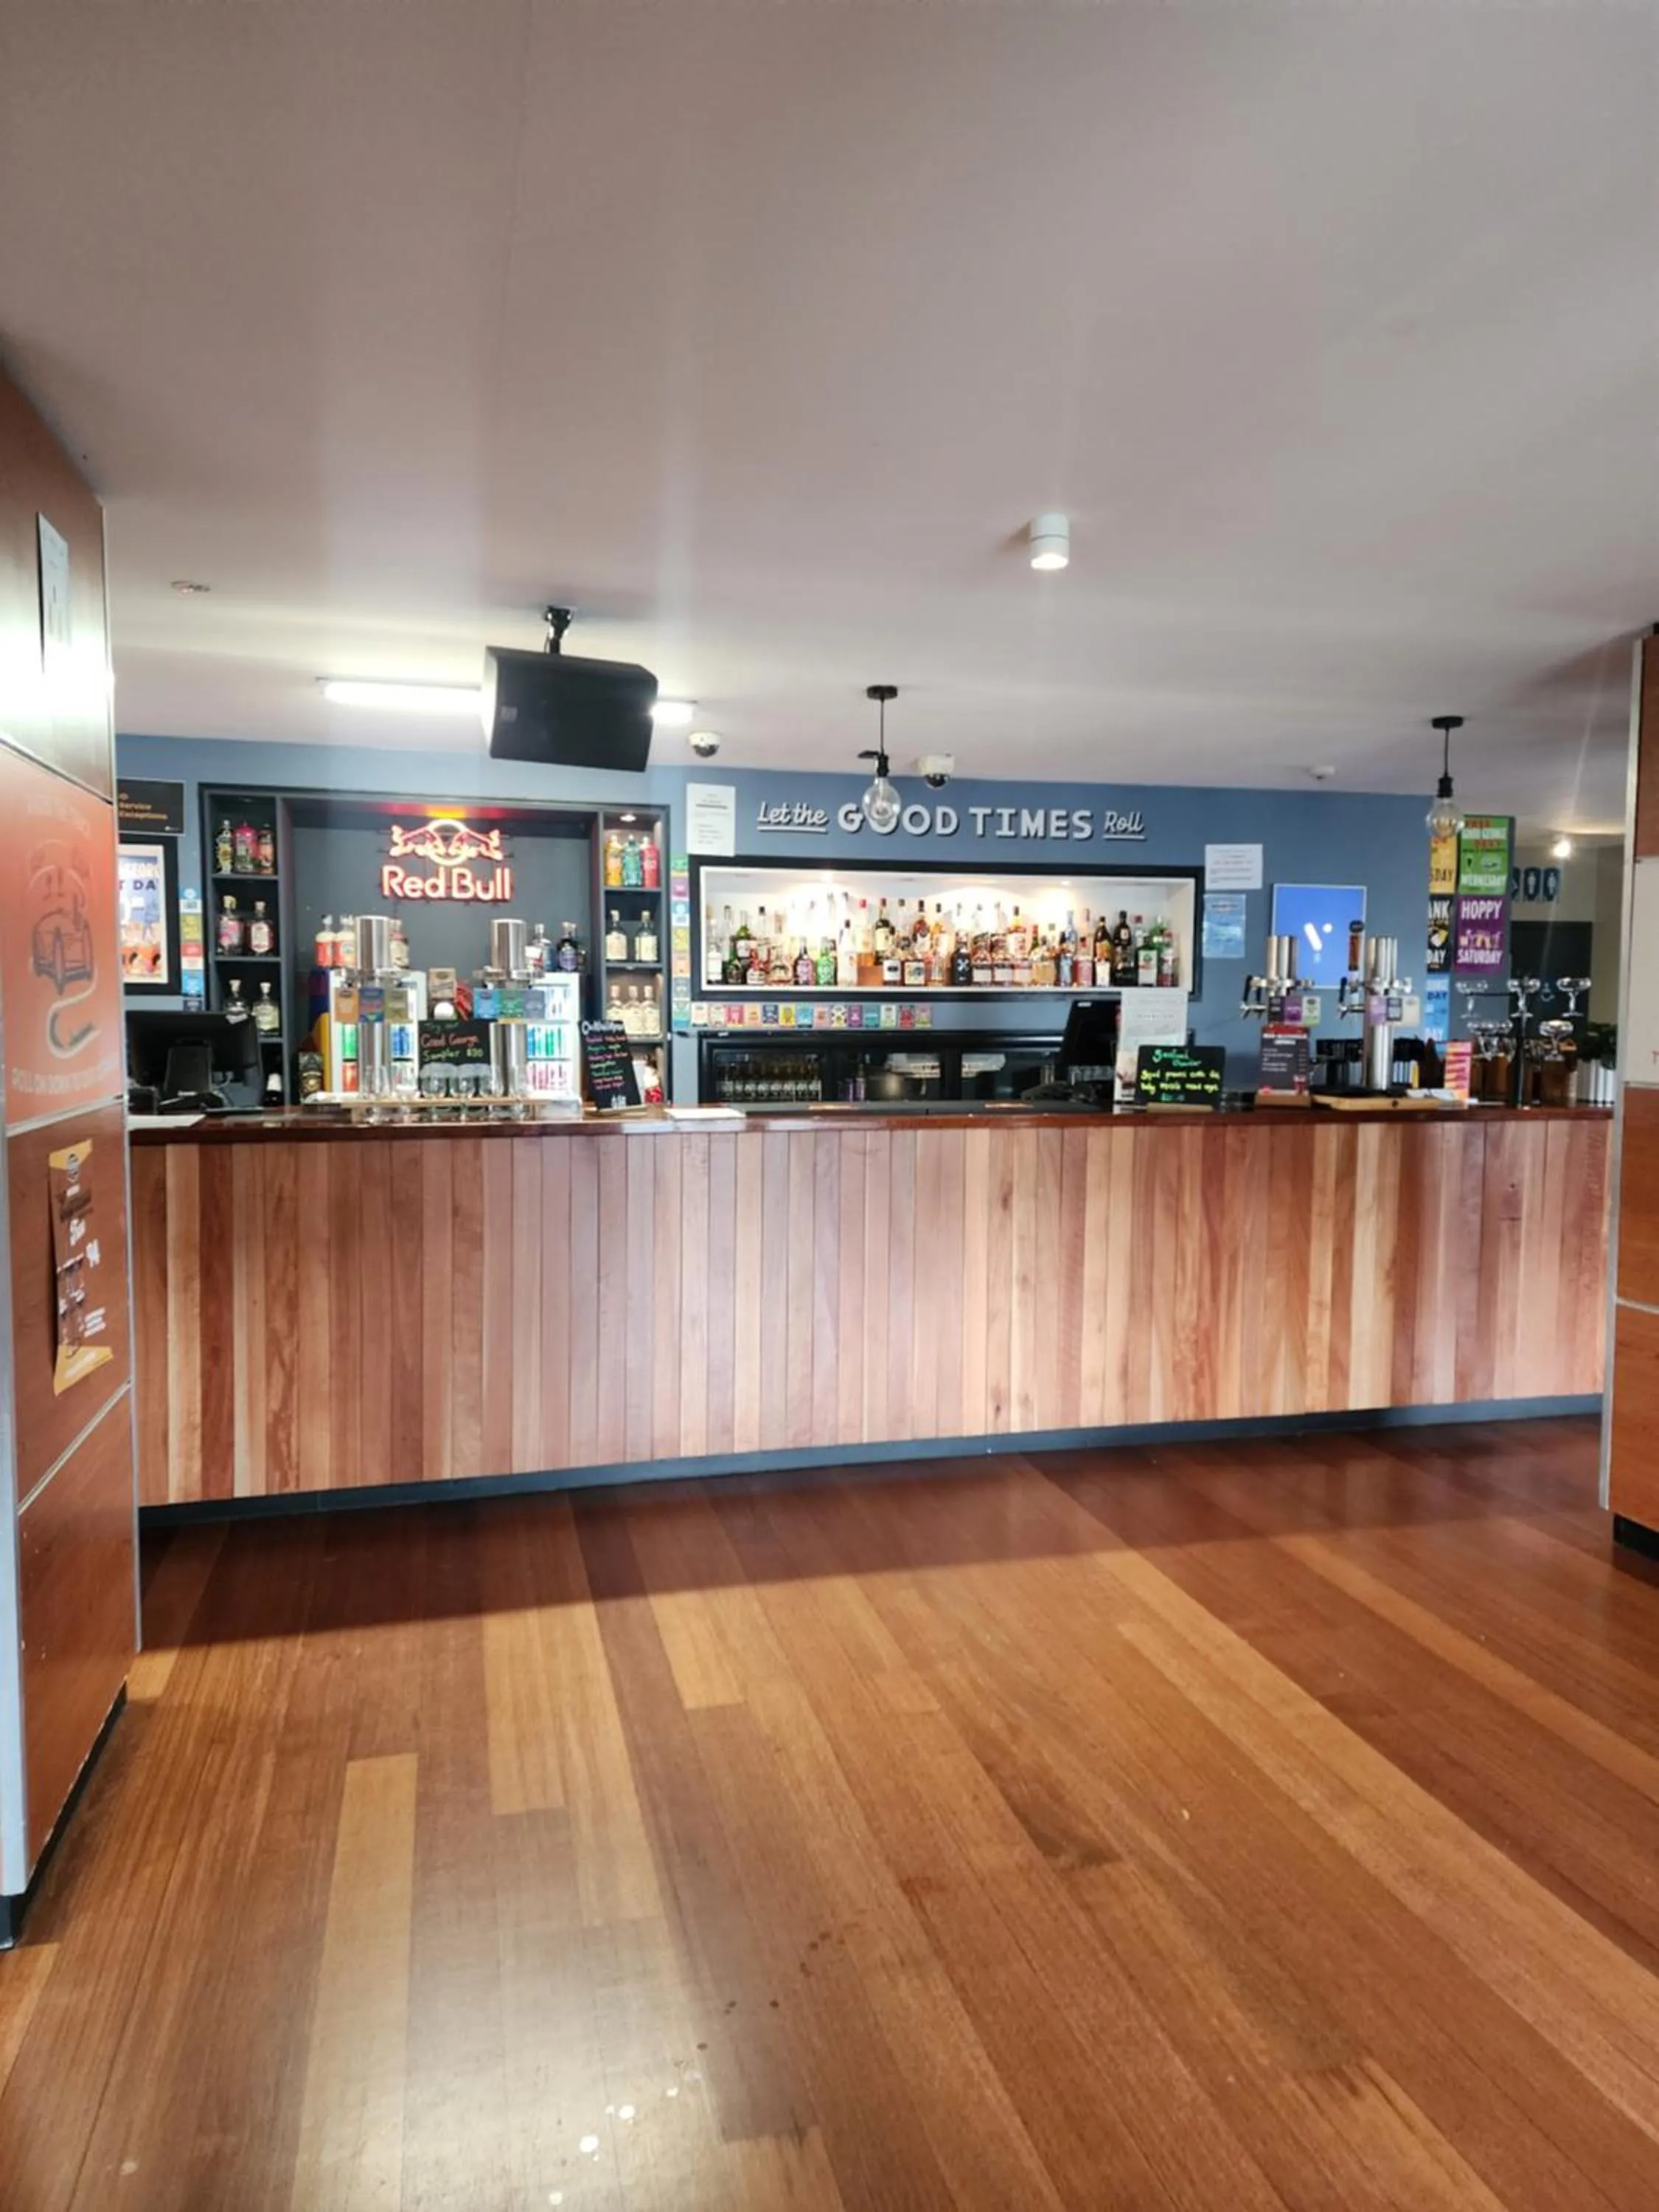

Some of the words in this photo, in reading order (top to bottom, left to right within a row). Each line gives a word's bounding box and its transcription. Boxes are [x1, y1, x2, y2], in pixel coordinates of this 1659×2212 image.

[757, 801, 790, 823] Let
[792, 801, 828, 824] the
[838, 802, 959, 835] GOOD
[969, 806, 1093, 839] TIMES
[1104, 810, 1144, 832] Roll
[133, 880, 159, 891] DA
[382, 864, 446, 898] Red
[451, 866, 511, 900] Bull
[1461, 900, 1503, 920] HOPPY
[1456, 949, 1503, 968] SATURDAY
